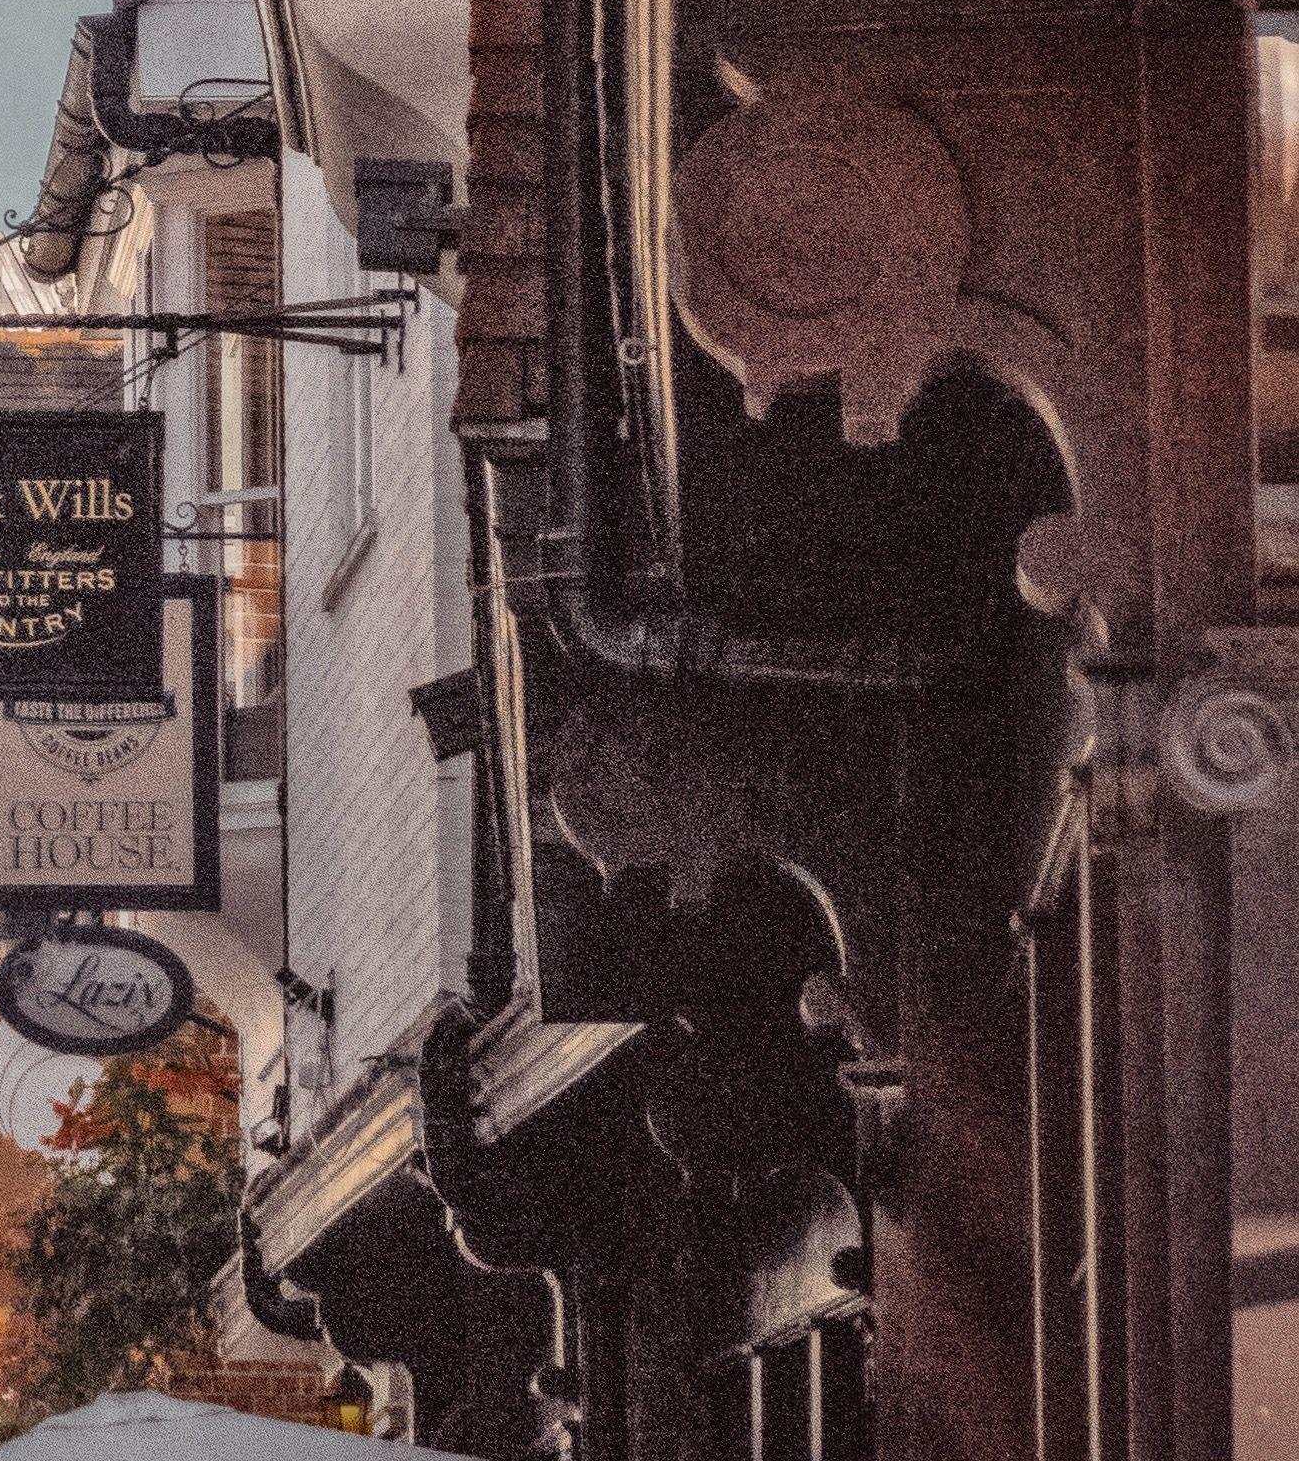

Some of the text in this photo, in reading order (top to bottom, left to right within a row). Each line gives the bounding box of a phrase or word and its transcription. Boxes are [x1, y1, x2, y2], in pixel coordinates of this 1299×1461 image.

[18, 477, 135, 521] Wills
[27, 540, 105, 569] England
[16, 593, 51, 608] THE
[13, 701, 53, 719] TASTE
[57, 702, 83, 720] THE
[41, 734, 139, 767] COFFEE BEANS
[8, 801, 174, 832] COFFEE
